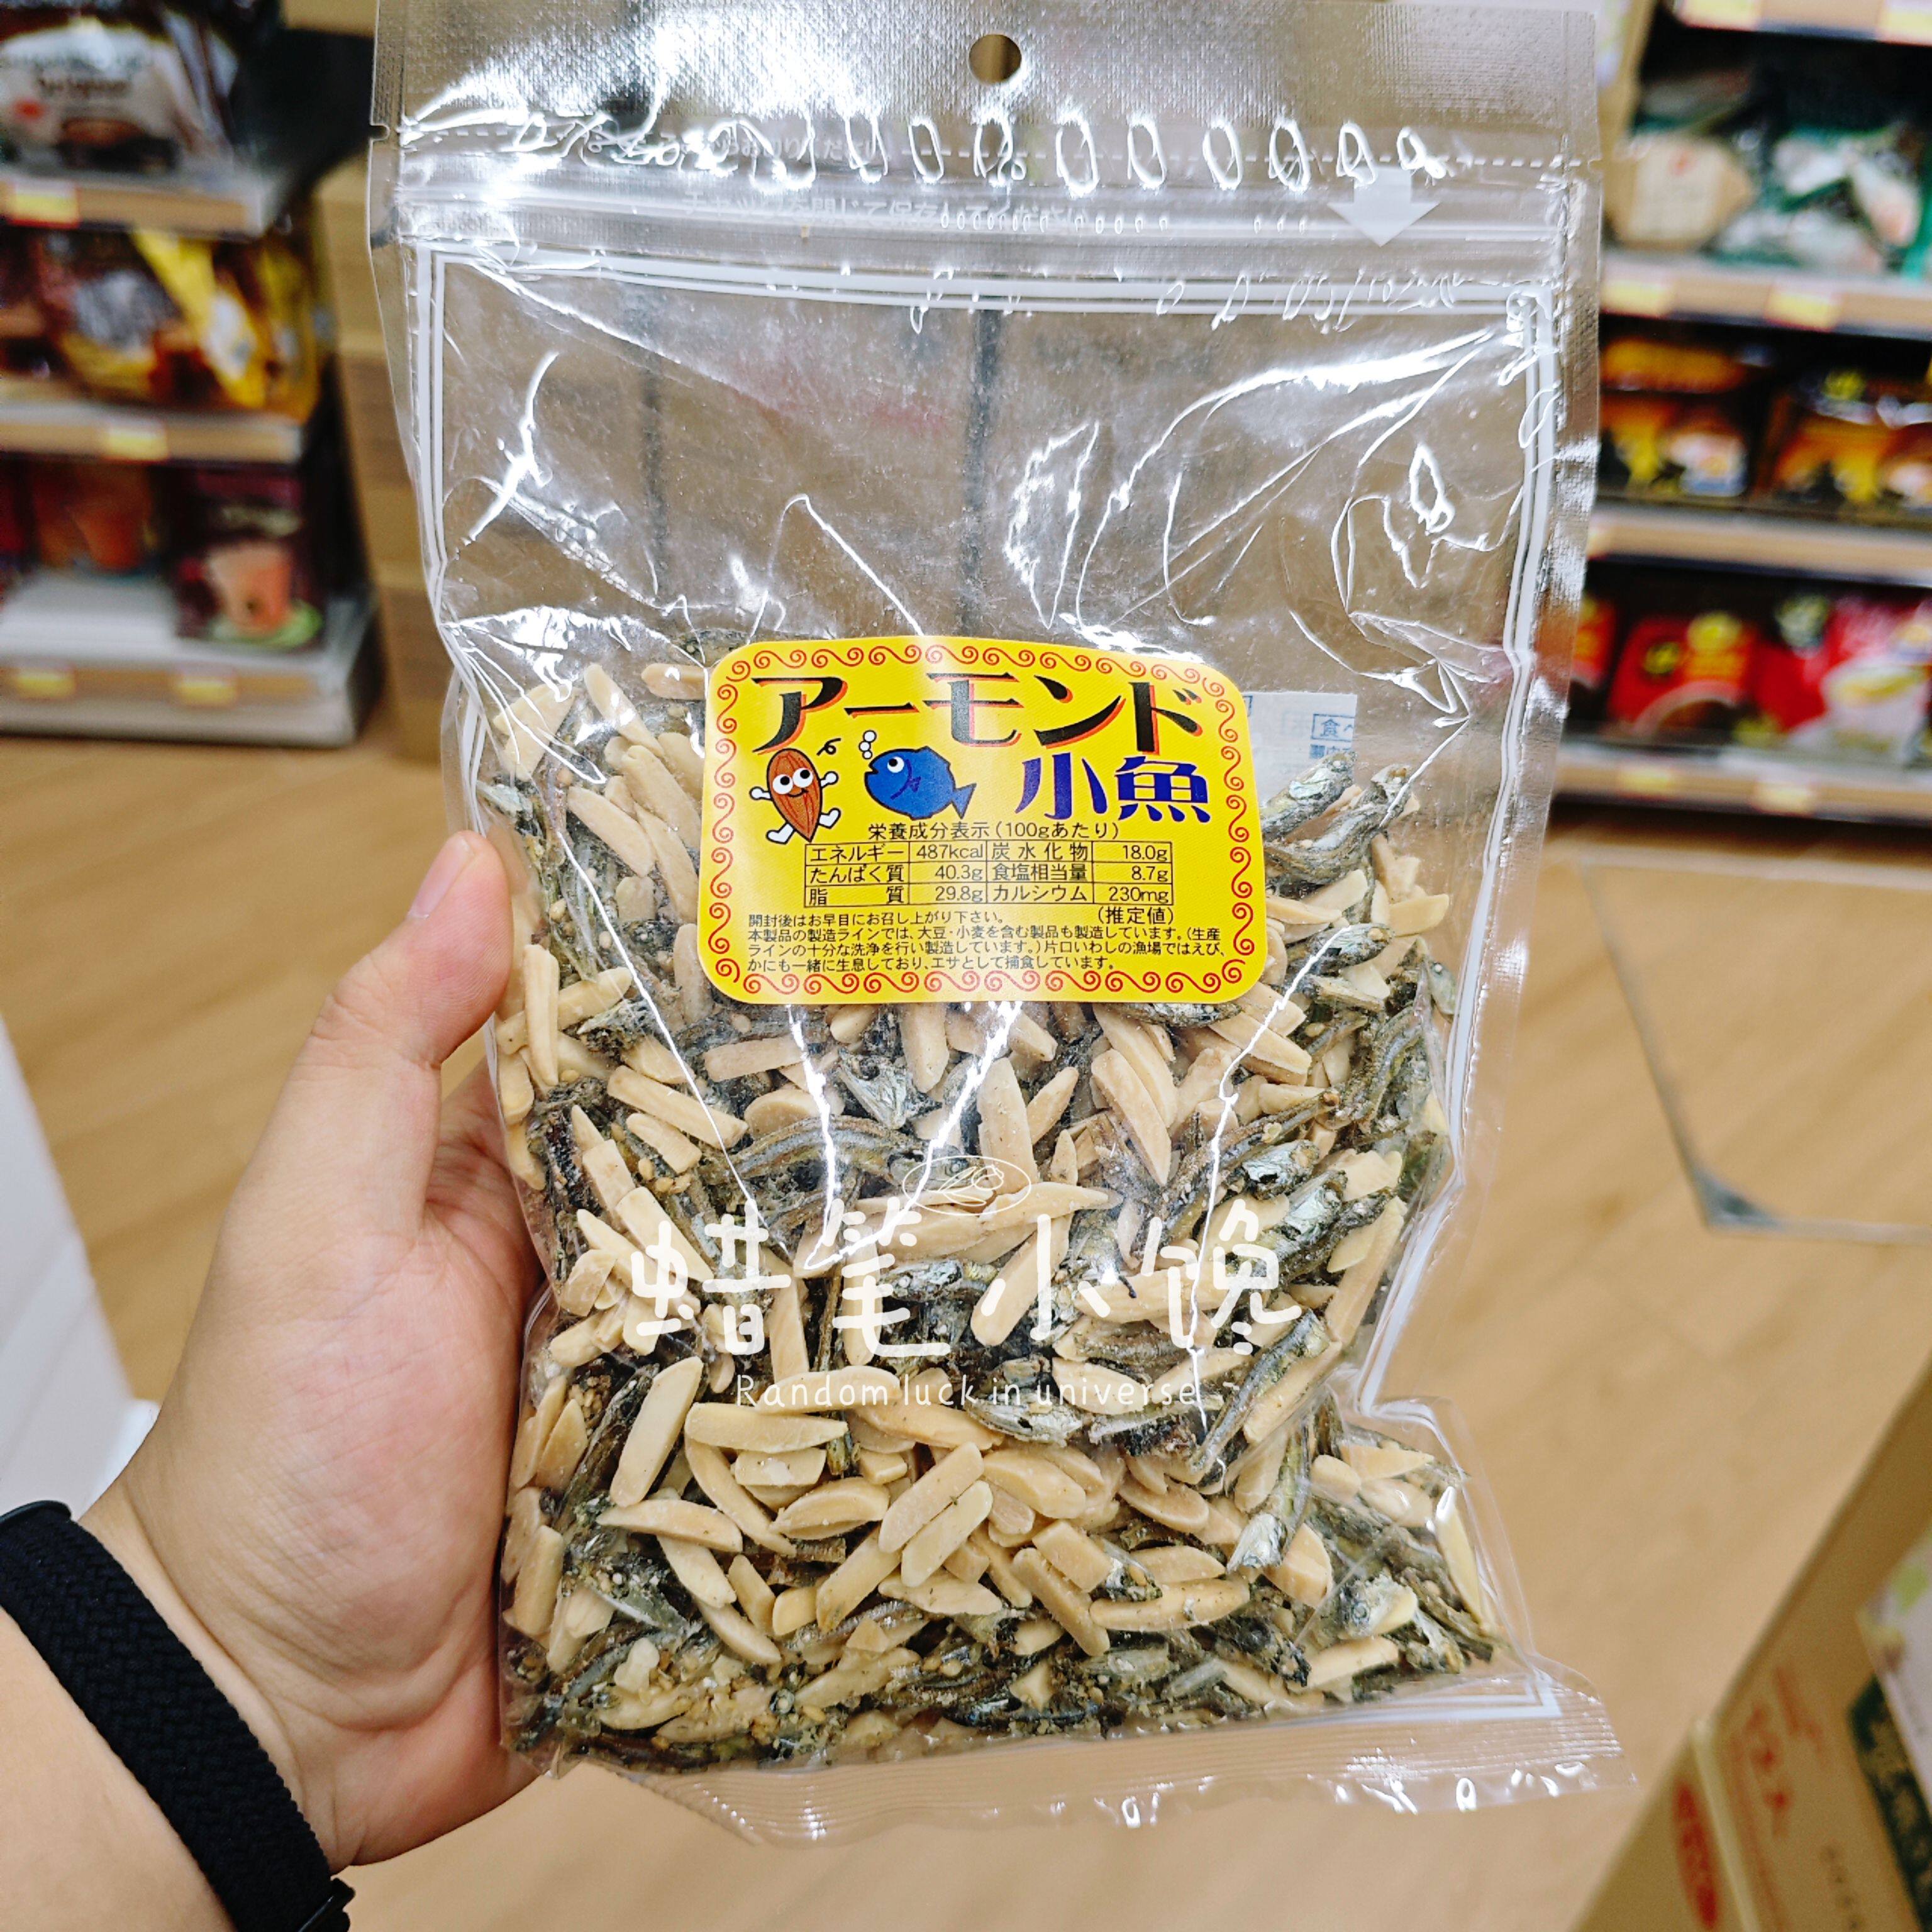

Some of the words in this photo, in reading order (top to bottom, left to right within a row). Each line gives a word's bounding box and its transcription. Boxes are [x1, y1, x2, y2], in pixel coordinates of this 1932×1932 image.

[752, 672, 1204, 755] アーモンド
[1014, 752, 1211, 823] 小魚
[810, 843, 904, 863] エネルギー
[916, 843, 984, 860] 487kcal
[1122, 845, 1168, 861] 18.0g
[810, 864, 904, 884] たんぱく質
[935, 865, 983, 882] 40.3g
[992, 863, 1088, 881] 食塩相当量
[1131, 865, 1169, 882] 8.7g
[935, 886, 983, 904] 29.8g
[992, 884, 1087, 902] カルシウム
[1108, 886, 1169, 904] 230mg
[1097, 906, 1174, 925] (推定値)
